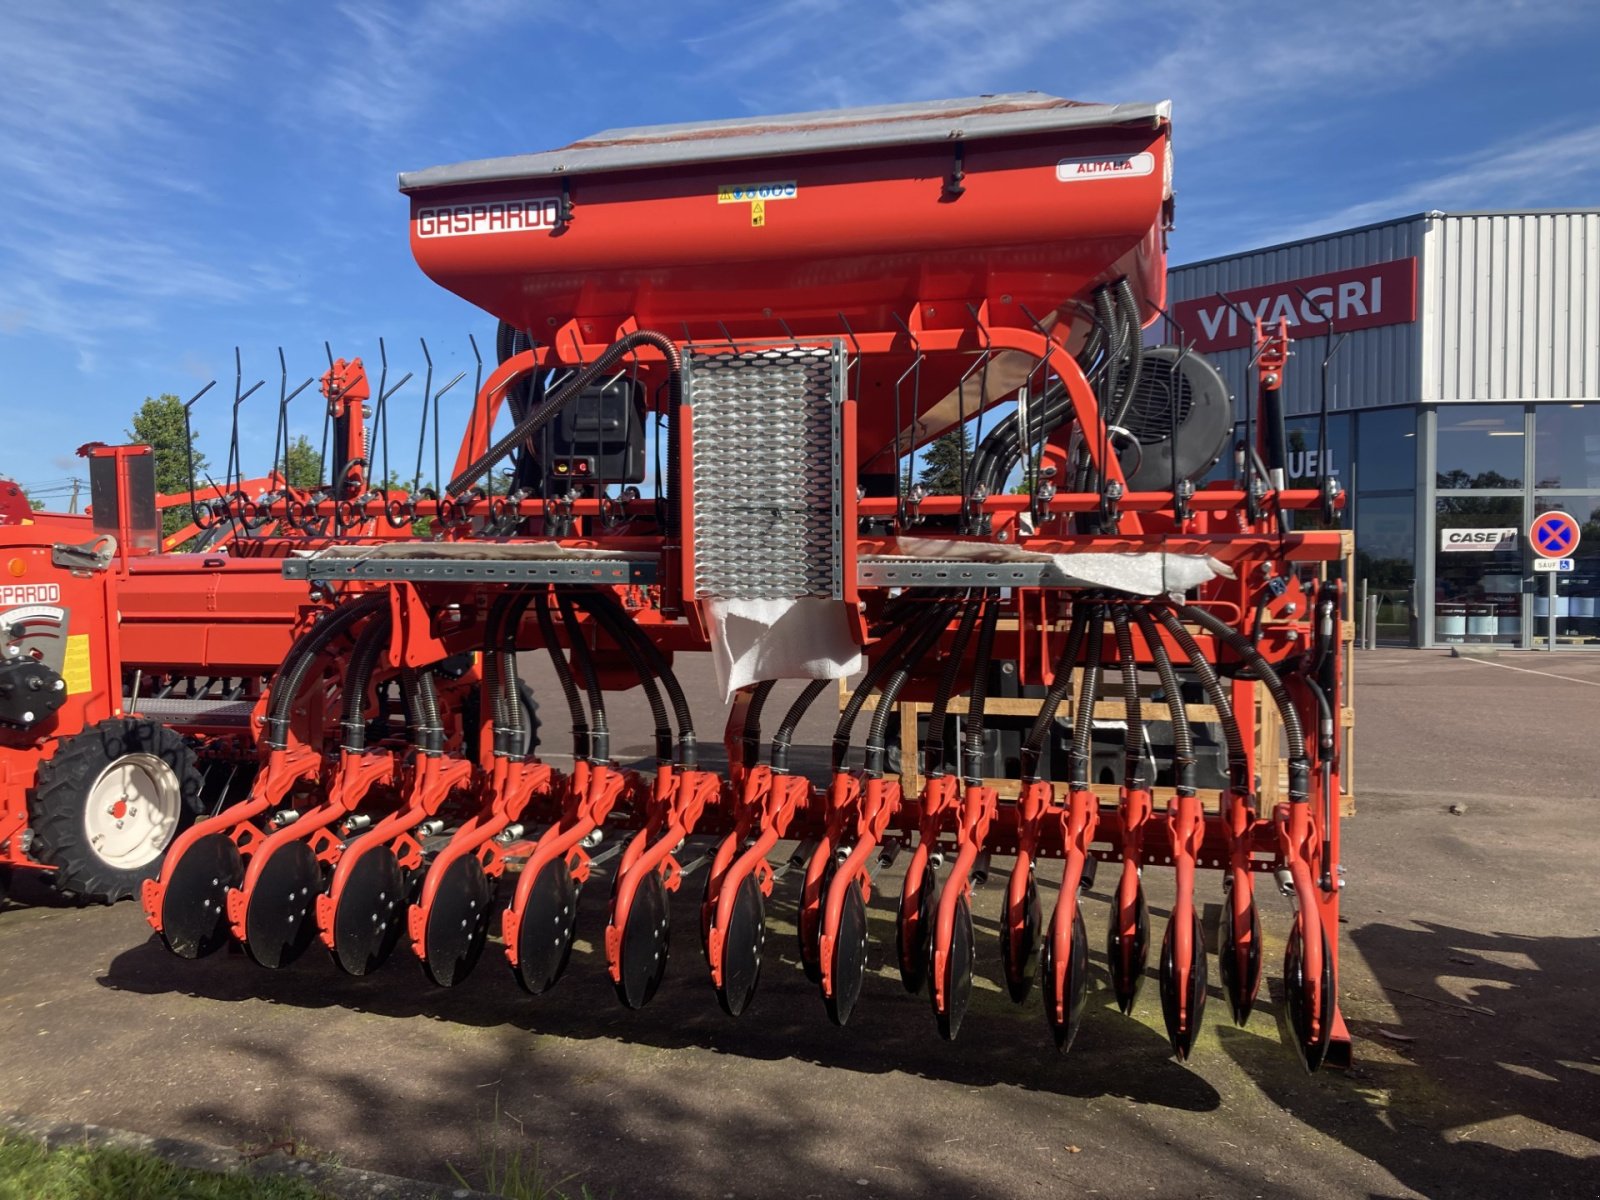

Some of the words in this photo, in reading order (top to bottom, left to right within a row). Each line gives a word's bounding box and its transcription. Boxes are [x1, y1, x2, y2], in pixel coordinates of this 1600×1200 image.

[1077, 160, 1133, 173] ALITALIA
[420, 200, 560, 235] GASPARDO
[1197, 276, 1382, 341] VIVAGRI
[1288, 449, 1340, 479] UEIL
[1449, 532, 1498, 543] CASE
[0, 585, 59, 603] PARDO
